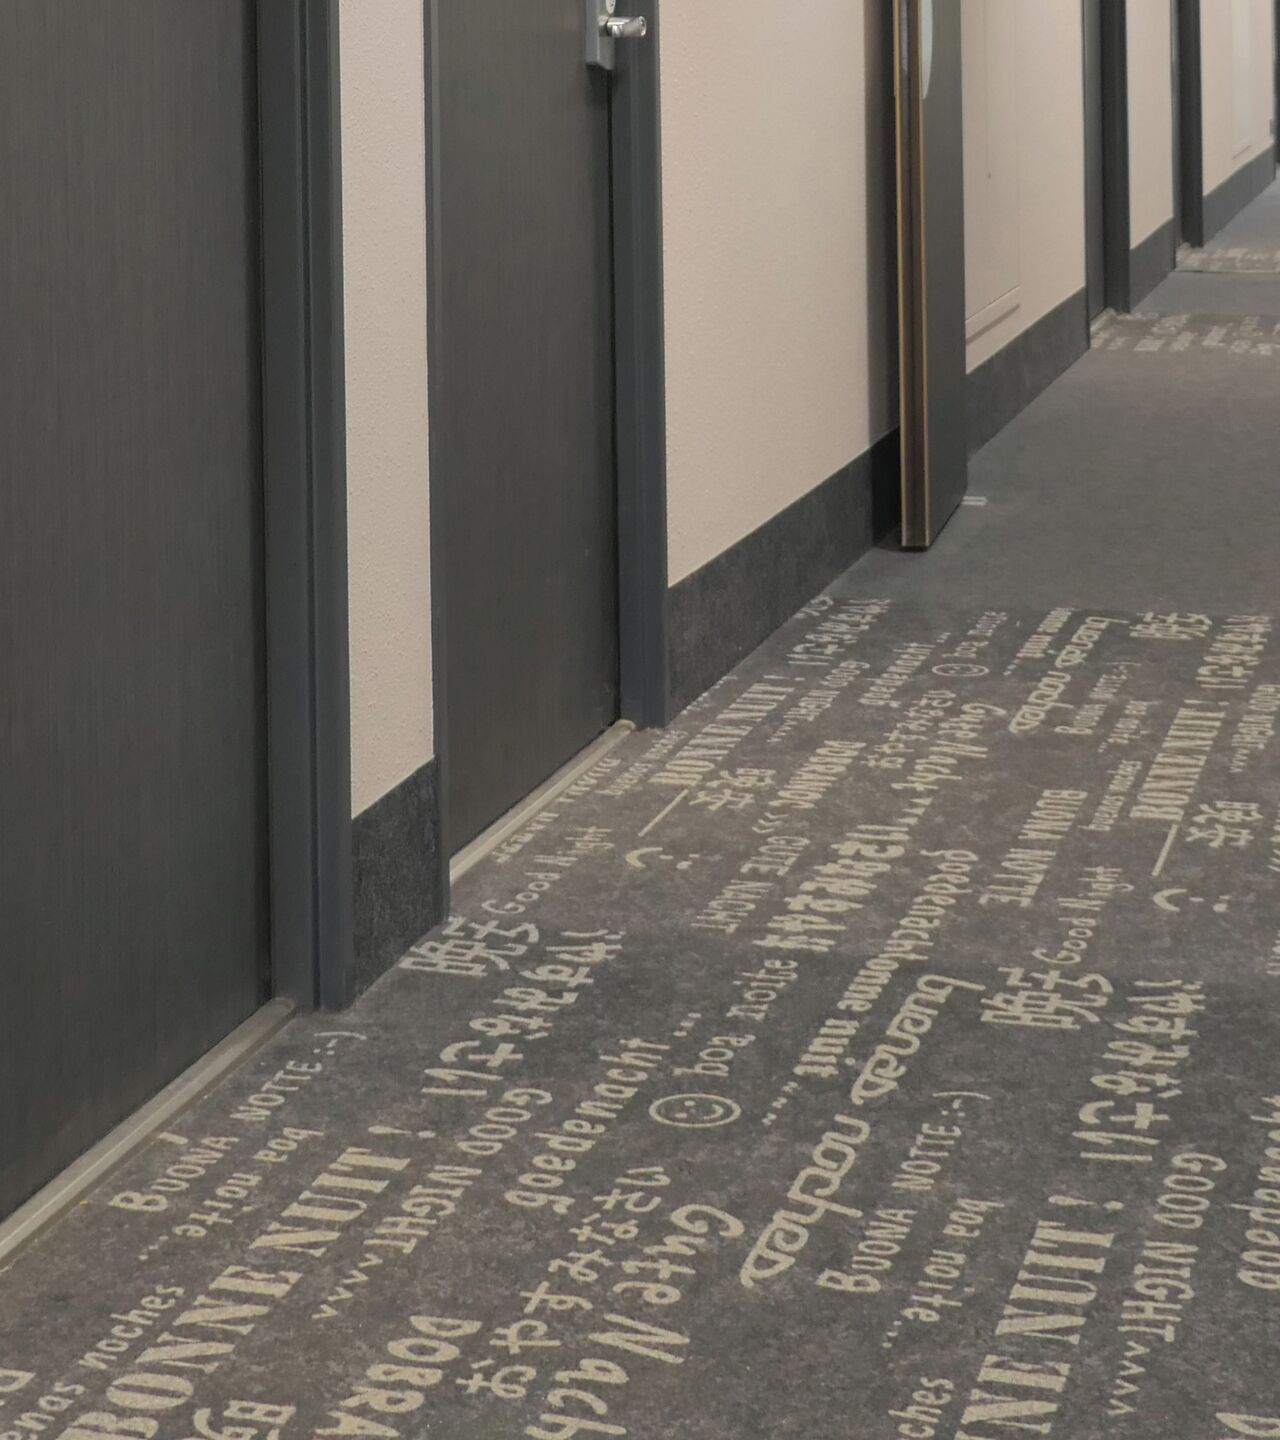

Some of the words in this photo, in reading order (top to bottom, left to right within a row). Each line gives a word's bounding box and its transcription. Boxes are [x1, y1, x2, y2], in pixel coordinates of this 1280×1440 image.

[672, 1033, 756, 1077] boa
[725, 959, 798, 1021] noite
[849, 973, 986, 1105] buenas
[108, 1136, 238, 1210] BUONA
[228, 1060, 322, 1120] NOTTE
[252, 1126, 325, 1161] boa
[455, 1086, 553, 1155] GOOD
[247, 1144, 413, 1258] NUIT
[364, 1165, 482, 1253] NIGHT
[738, 1113, 870, 1289] noches
[814, 1208, 916, 1293] BUONA
[890, 1122, 962, 1190] NOTTE
[942, 1197, 1005, 1237] boa
[1152, 1151, 1227, 1229] GOOD
[611, 1200, 745, 1306] Gute
[993, 1216, 1115, 1347] NUIT
[1117, 1240, 1198, 1342] NIGHT
[315, 1315, 482, 1440] DOBRA
[525, 1313, 691, 1440] Nach
[888, 1377, 955, 1440] ches
